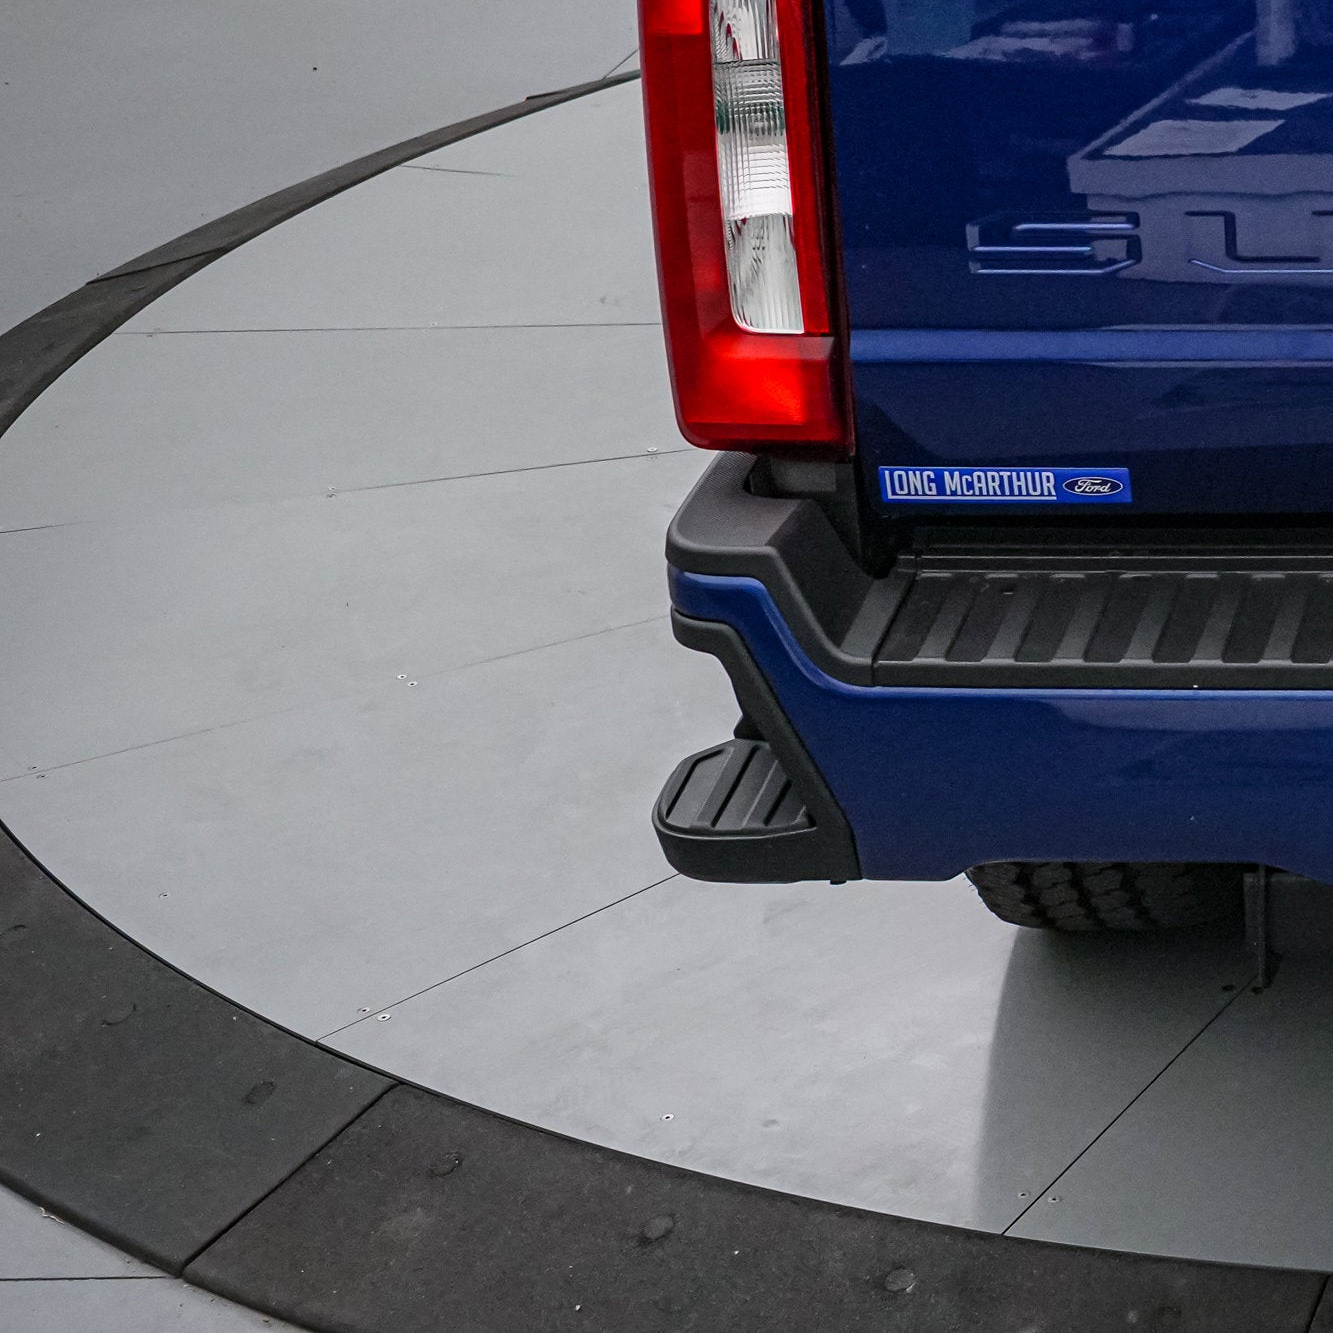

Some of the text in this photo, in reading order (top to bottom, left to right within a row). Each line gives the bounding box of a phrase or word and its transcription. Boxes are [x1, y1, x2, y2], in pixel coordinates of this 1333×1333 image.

[884, 470, 1112, 499] LONG McARTHUR Ford
